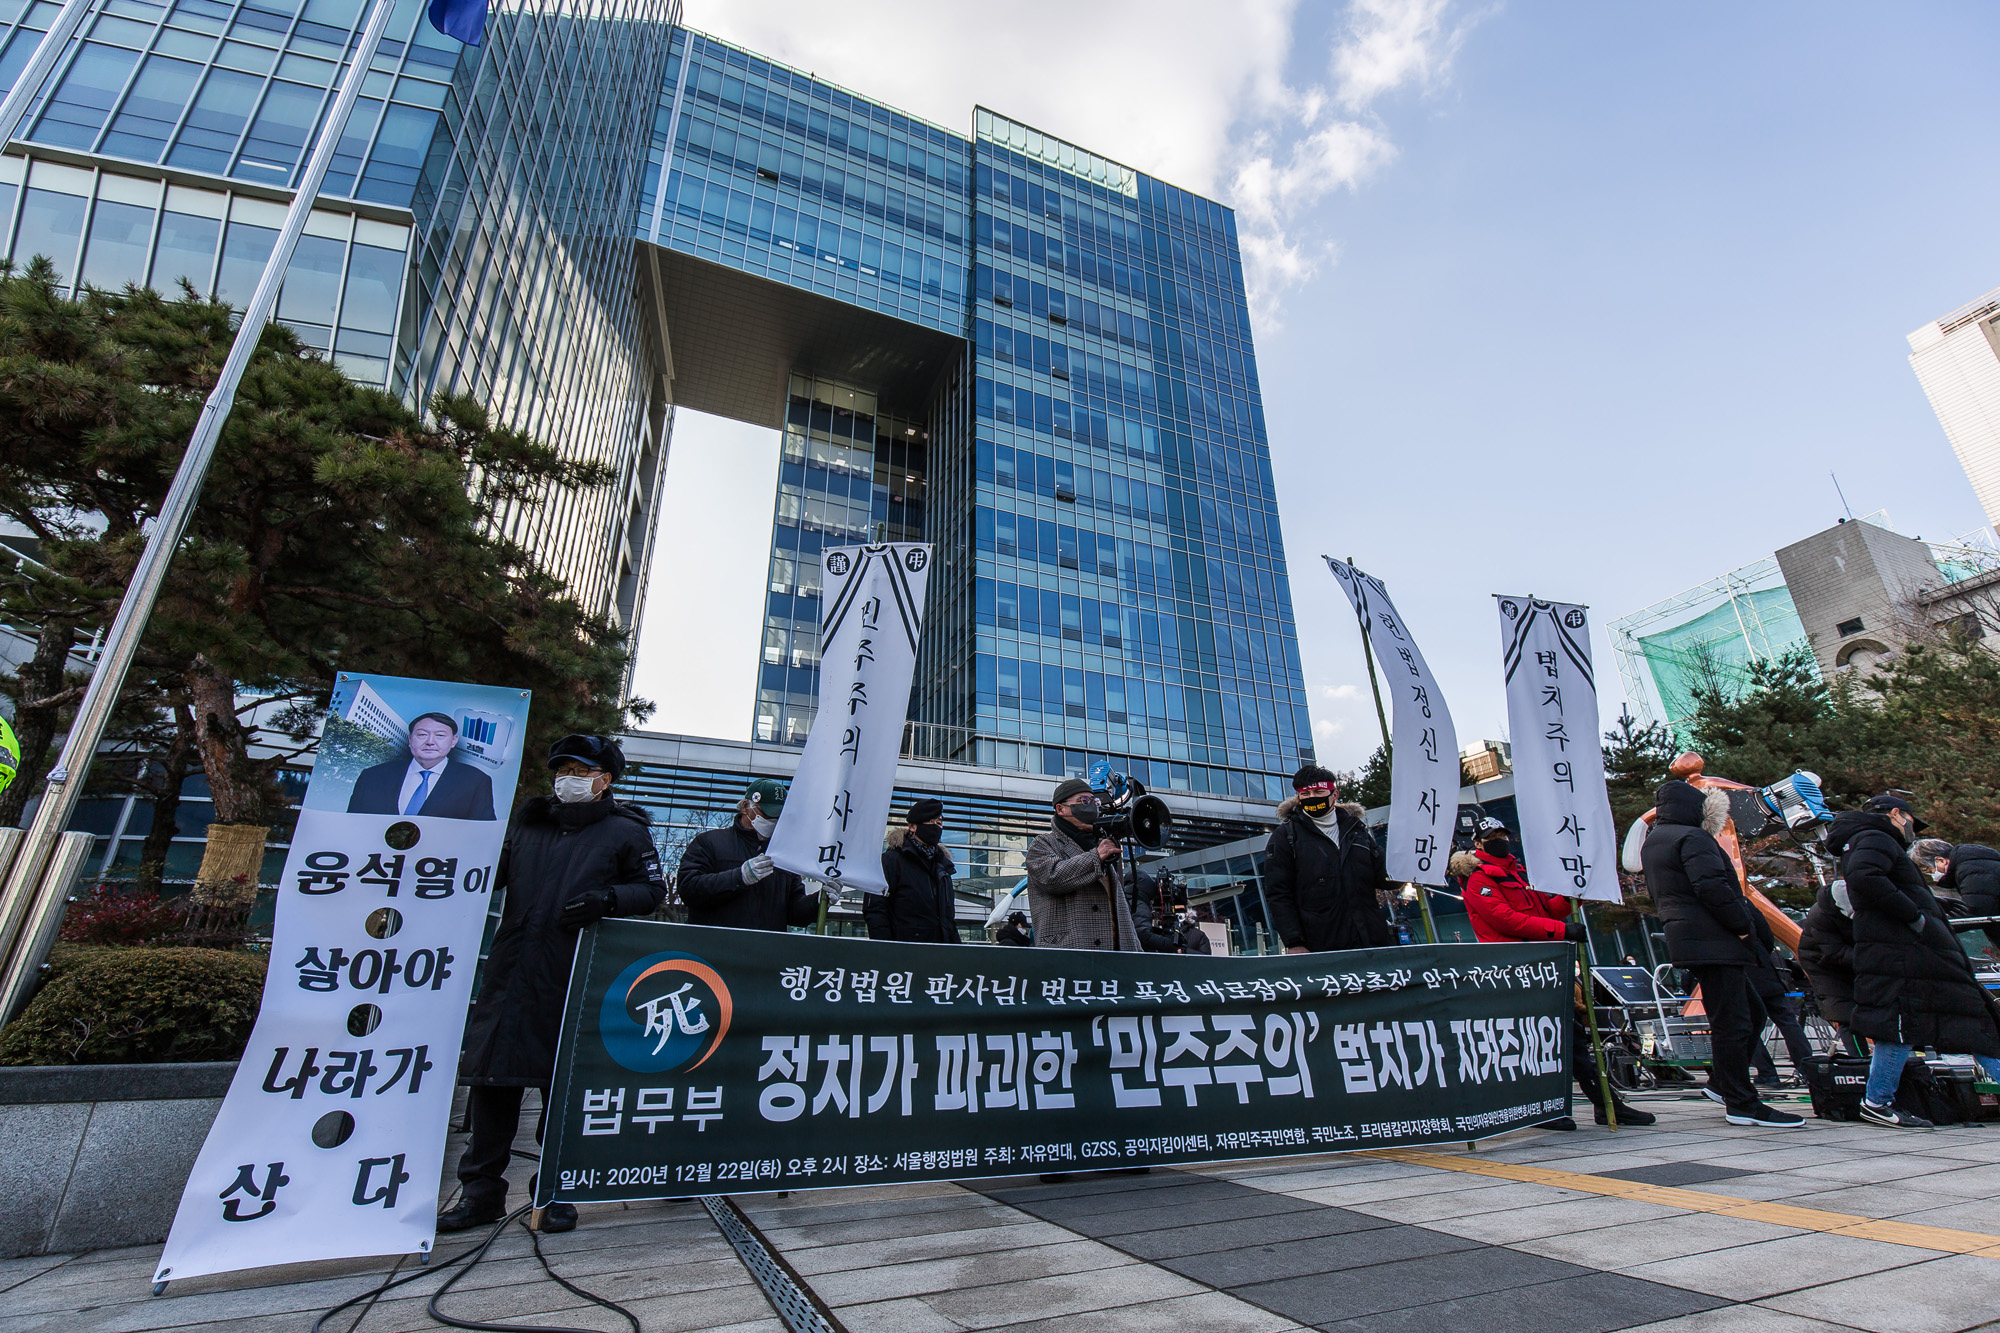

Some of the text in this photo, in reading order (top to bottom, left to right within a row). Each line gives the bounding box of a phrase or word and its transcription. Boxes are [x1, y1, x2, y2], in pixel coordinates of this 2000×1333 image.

[829, 551, 925, 573] 謹 弔
[818, 596, 881, 879] 민주주의 사망
[1378, 613, 1440, 872] 헌법정신 사망
[1535, 650, 1591, 888] 법치주의 사망
[298, 852, 491, 899] 윤석열이
[295, 947, 454, 994] 살아야
[780, 966, 913, 1003] 행정법원
[925, 974, 1027, 1005] 판사님!
[1042, 978, 1125, 1005] 법무부
[1195, 977, 1302, 1002] 바로잡아
[1515, 962, 1561, 988] 합니다.
[635, 982, 710, 1056] 死
[262, 1045, 432, 1099] 나라가
[758, 1035, 918, 1121] 정치가
[935, 1031, 1077, 1112] 파괴한
[1334, 1020, 1446, 1093] 법치가
[1450, 1016, 1562, 1084] 지켜주세요!
[1834, 1075, 1866, 1085] MBC
[583, 1086, 723, 1135] 법무부
[561, 1169, 600, 1189] 일시:
[607, 1165, 667, 1185] 2020년
[676, 1163, 711, 1182] 12월
[717, 1159, 781, 1179] 22일(화)
[786, 1158, 817, 1176] 오후
[823, 1156, 846, 1174] 2시
[854, 1155, 887, 1173] 장소:
[893, 1149, 977, 1170] 서울행정법원
[984, 1147, 1015, 1165] 주최:
[1021, 1143, 1076, 1162] 자유연대,
[1082, 1141, 1120, 1157] GZSS,
[1125, 1135, 1212, 1156] 공익지킴이센터,
[1216, 1128, 1309, 1149] 자유민주국민연합,
[1312, 1126, 1358, 1142] 국민노조,
[1361, 1118, 1454, 1138] 프리덤칼리지장학회,
